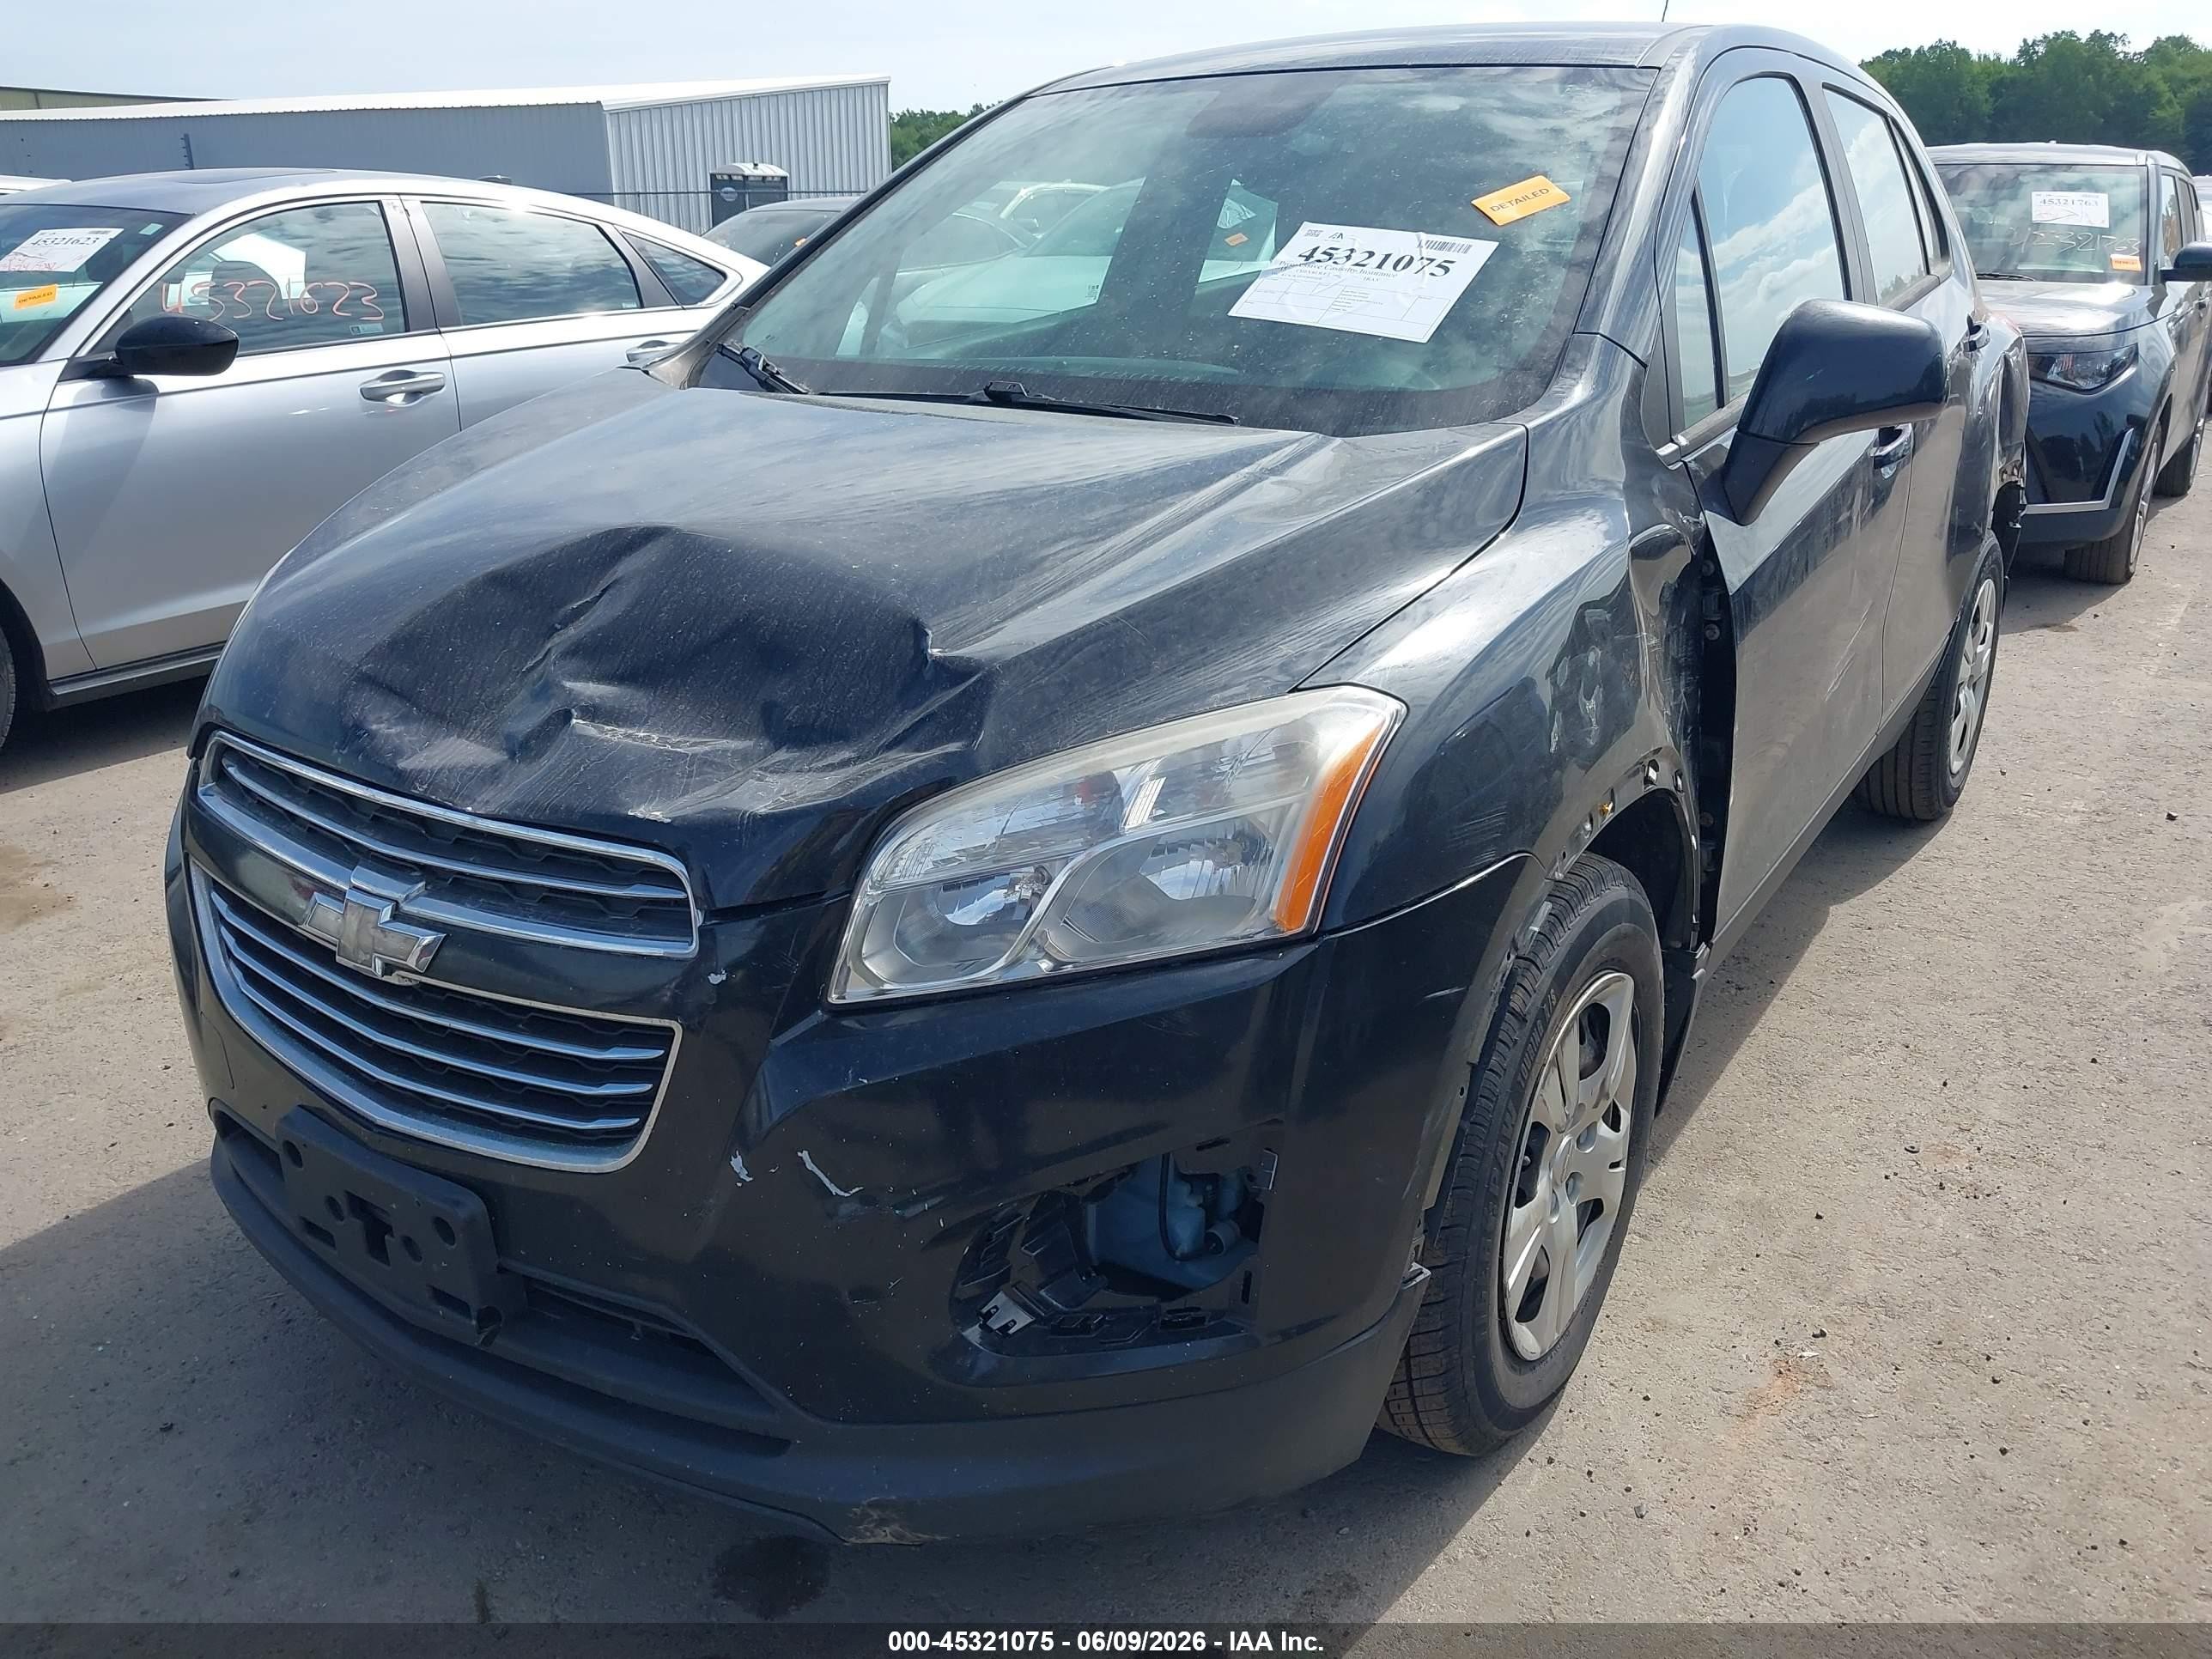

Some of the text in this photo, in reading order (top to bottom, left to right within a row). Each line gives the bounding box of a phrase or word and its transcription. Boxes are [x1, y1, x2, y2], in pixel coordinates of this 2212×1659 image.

[1490, 188, 1550, 212] DETAILED
[31, 237, 100, 246] 45321623
[1297, 246, 1457, 277] 45321075
[161, 277, 385, 322] 45321623
